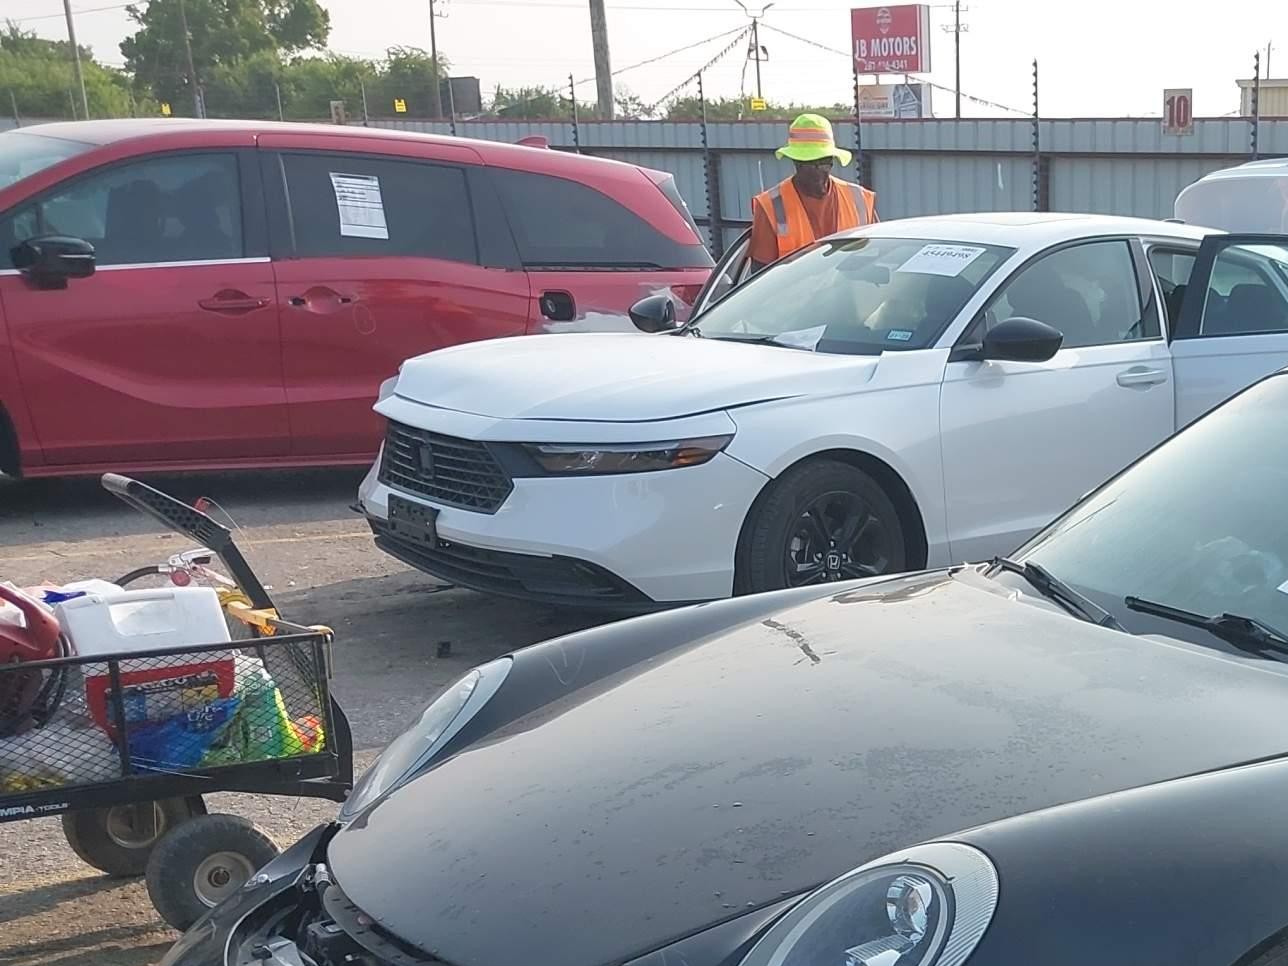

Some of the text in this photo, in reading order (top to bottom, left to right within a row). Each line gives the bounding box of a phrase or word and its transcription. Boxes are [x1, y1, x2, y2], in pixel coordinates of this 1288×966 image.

[855, 36, 917, 57] JB MOTORS
[1166, 95, 1189, 128] 10
